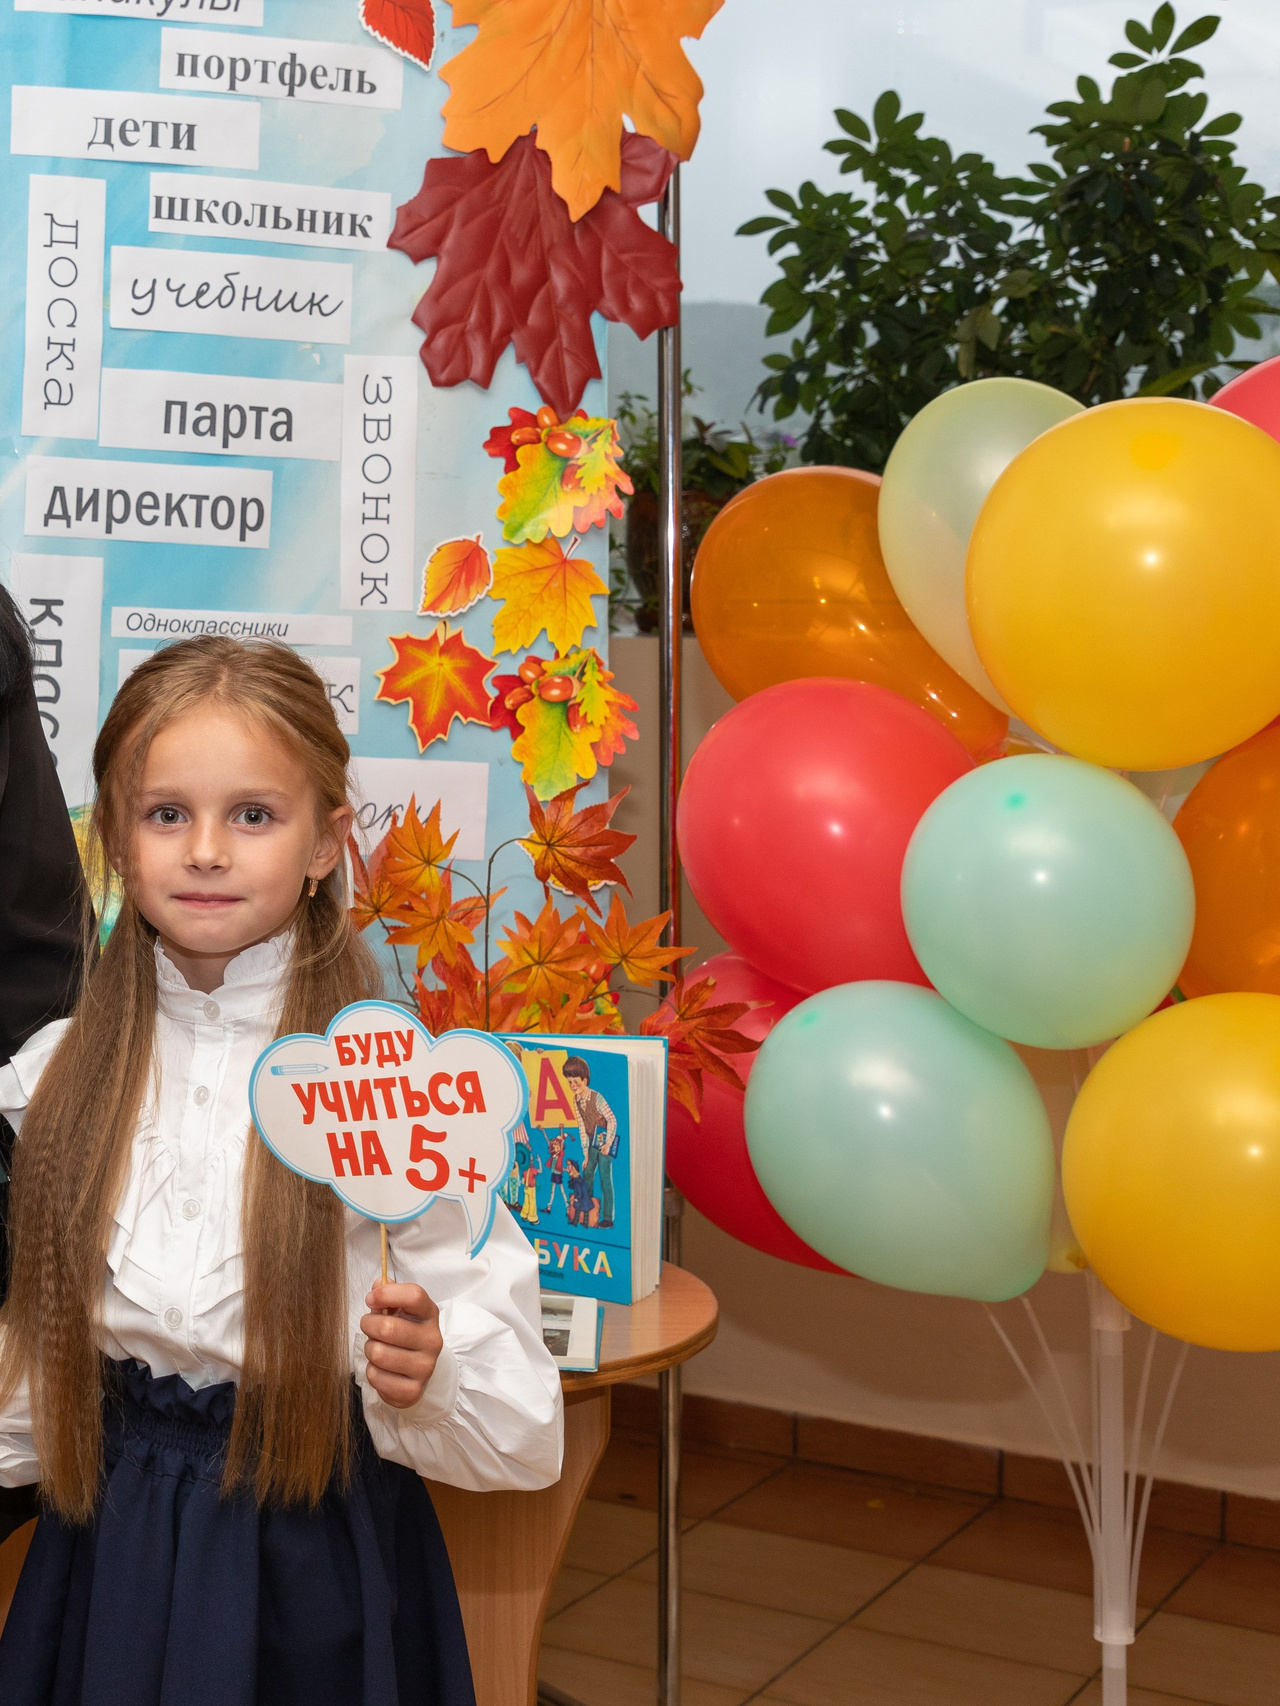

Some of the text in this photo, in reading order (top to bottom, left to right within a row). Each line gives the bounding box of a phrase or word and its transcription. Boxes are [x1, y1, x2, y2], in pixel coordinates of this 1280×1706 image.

[176, 52, 378, 97] портфель
[88, 116, 197, 152] дети
[153, 194, 372, 238] школьник
[132, 272, 344, 317] учебник
[163, 399, 294, 449] парта
[361, 374, 393, 606] звонок
[43, 485, 265, 542] директор
[125, 612, 289, 637] Одноклассники
[29, 598, 64, 768] клас
[334, 1029, 415, 1068] БУДУ
[291, 1071, 487, 1125] УЧИТЬСЯ
[534, 1057, 576, 1122] А
[326, 1130, 392, 1178] НА
[534, 1238, 613, 1278] БУКА
